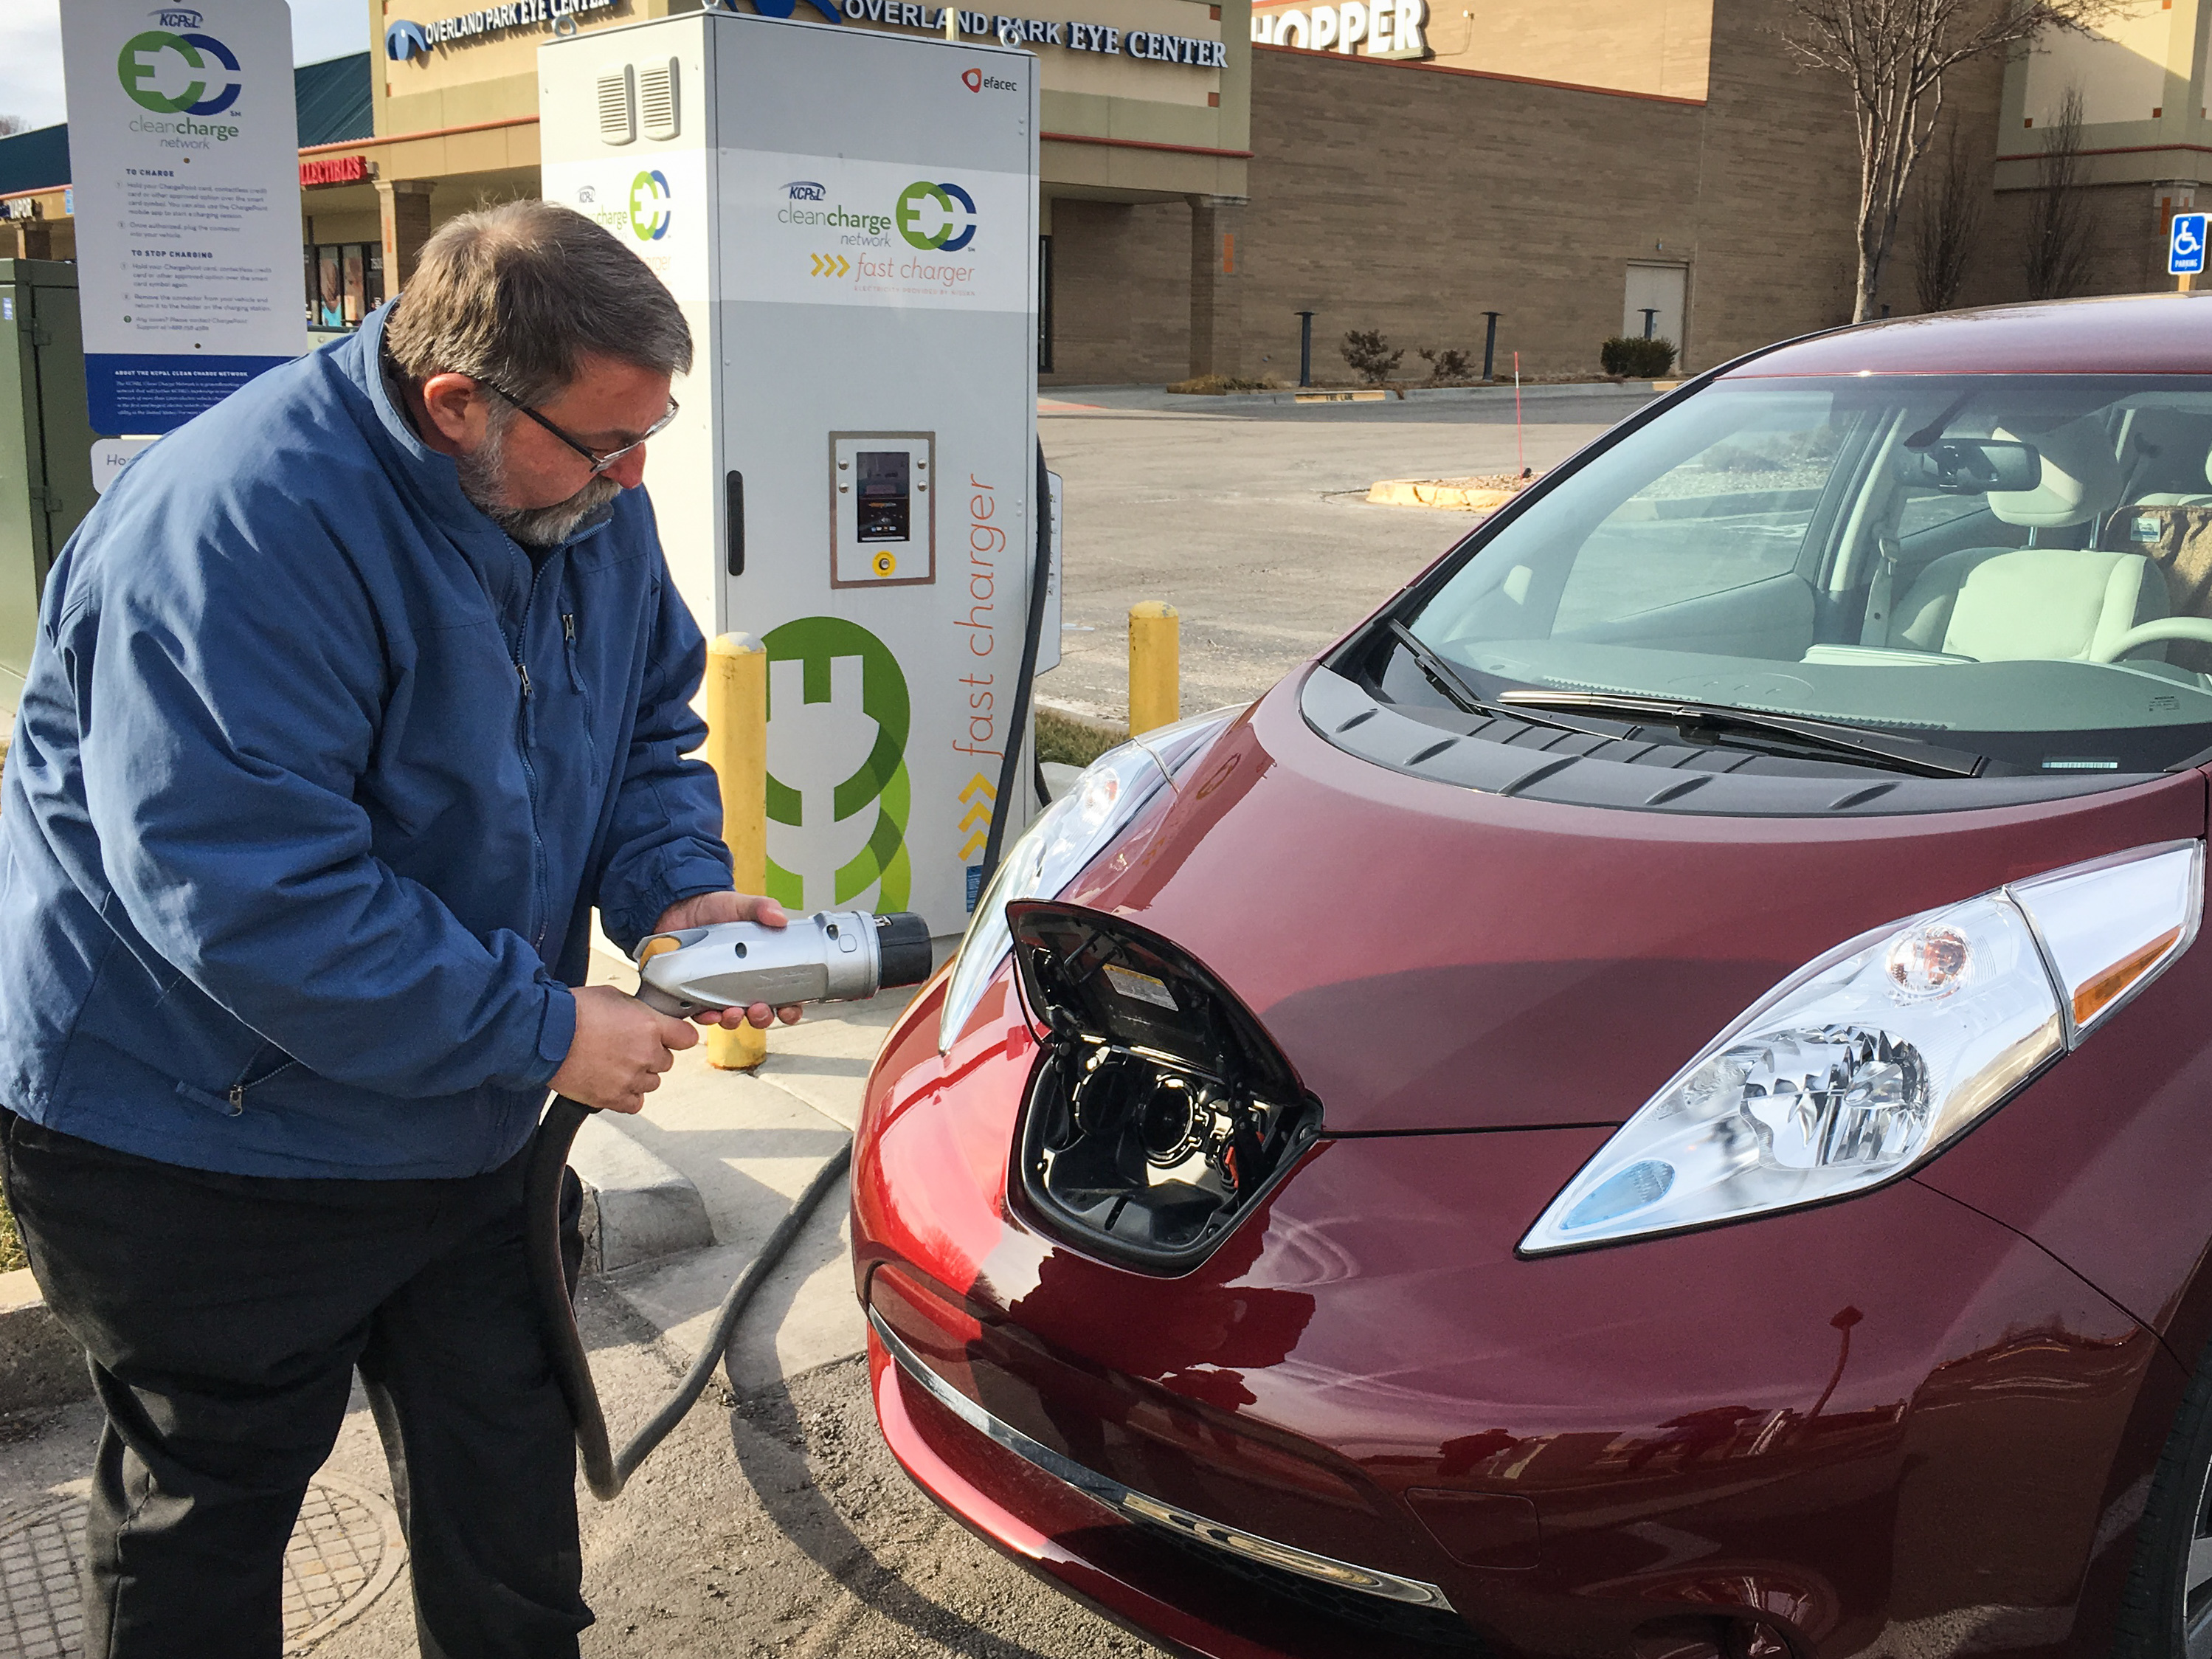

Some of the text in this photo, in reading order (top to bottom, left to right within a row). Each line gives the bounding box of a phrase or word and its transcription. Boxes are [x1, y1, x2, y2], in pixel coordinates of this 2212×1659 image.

[425, 10, 483, 44] OVERLAND
[486, 3, 517, 30] PARK
[519, 0, 547, 24] EYE
[846, 0, 1228, 68] OVERLAND PARK EYE CENTER
[984, 77, 1017, 92] efacec
[160, 137, 210, 150] network
[789, 187, 823, 201] KCP&L
[840, 232, 891, 247] network
[855, 252, 975, 287] fast charger
[2175, 259, 2198, 268] PARKING
[107, 455, 131, 466] Ho
[953, 473, 1006, 760] fast charger
